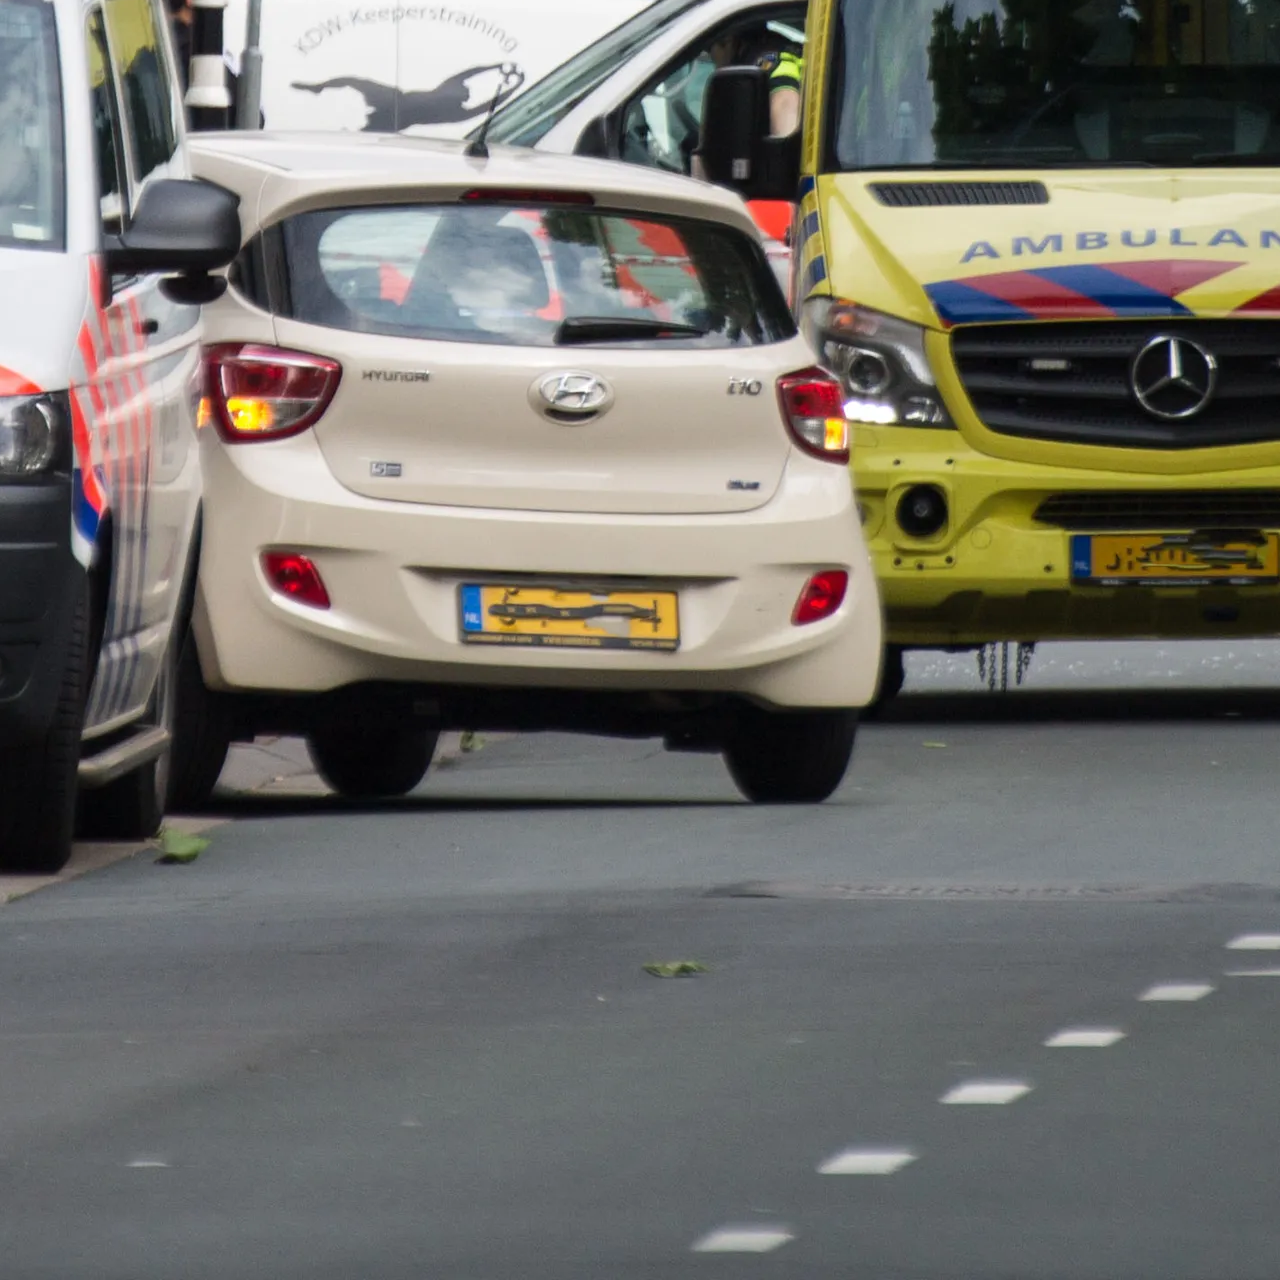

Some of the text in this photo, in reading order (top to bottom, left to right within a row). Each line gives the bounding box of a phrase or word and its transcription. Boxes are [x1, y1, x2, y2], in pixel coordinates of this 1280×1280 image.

[293, 4, 519, 55] KDW-Keeperstraining
[361, 369, 429, 382] HYUNDAI
[464, 612, 480, 624] NL
